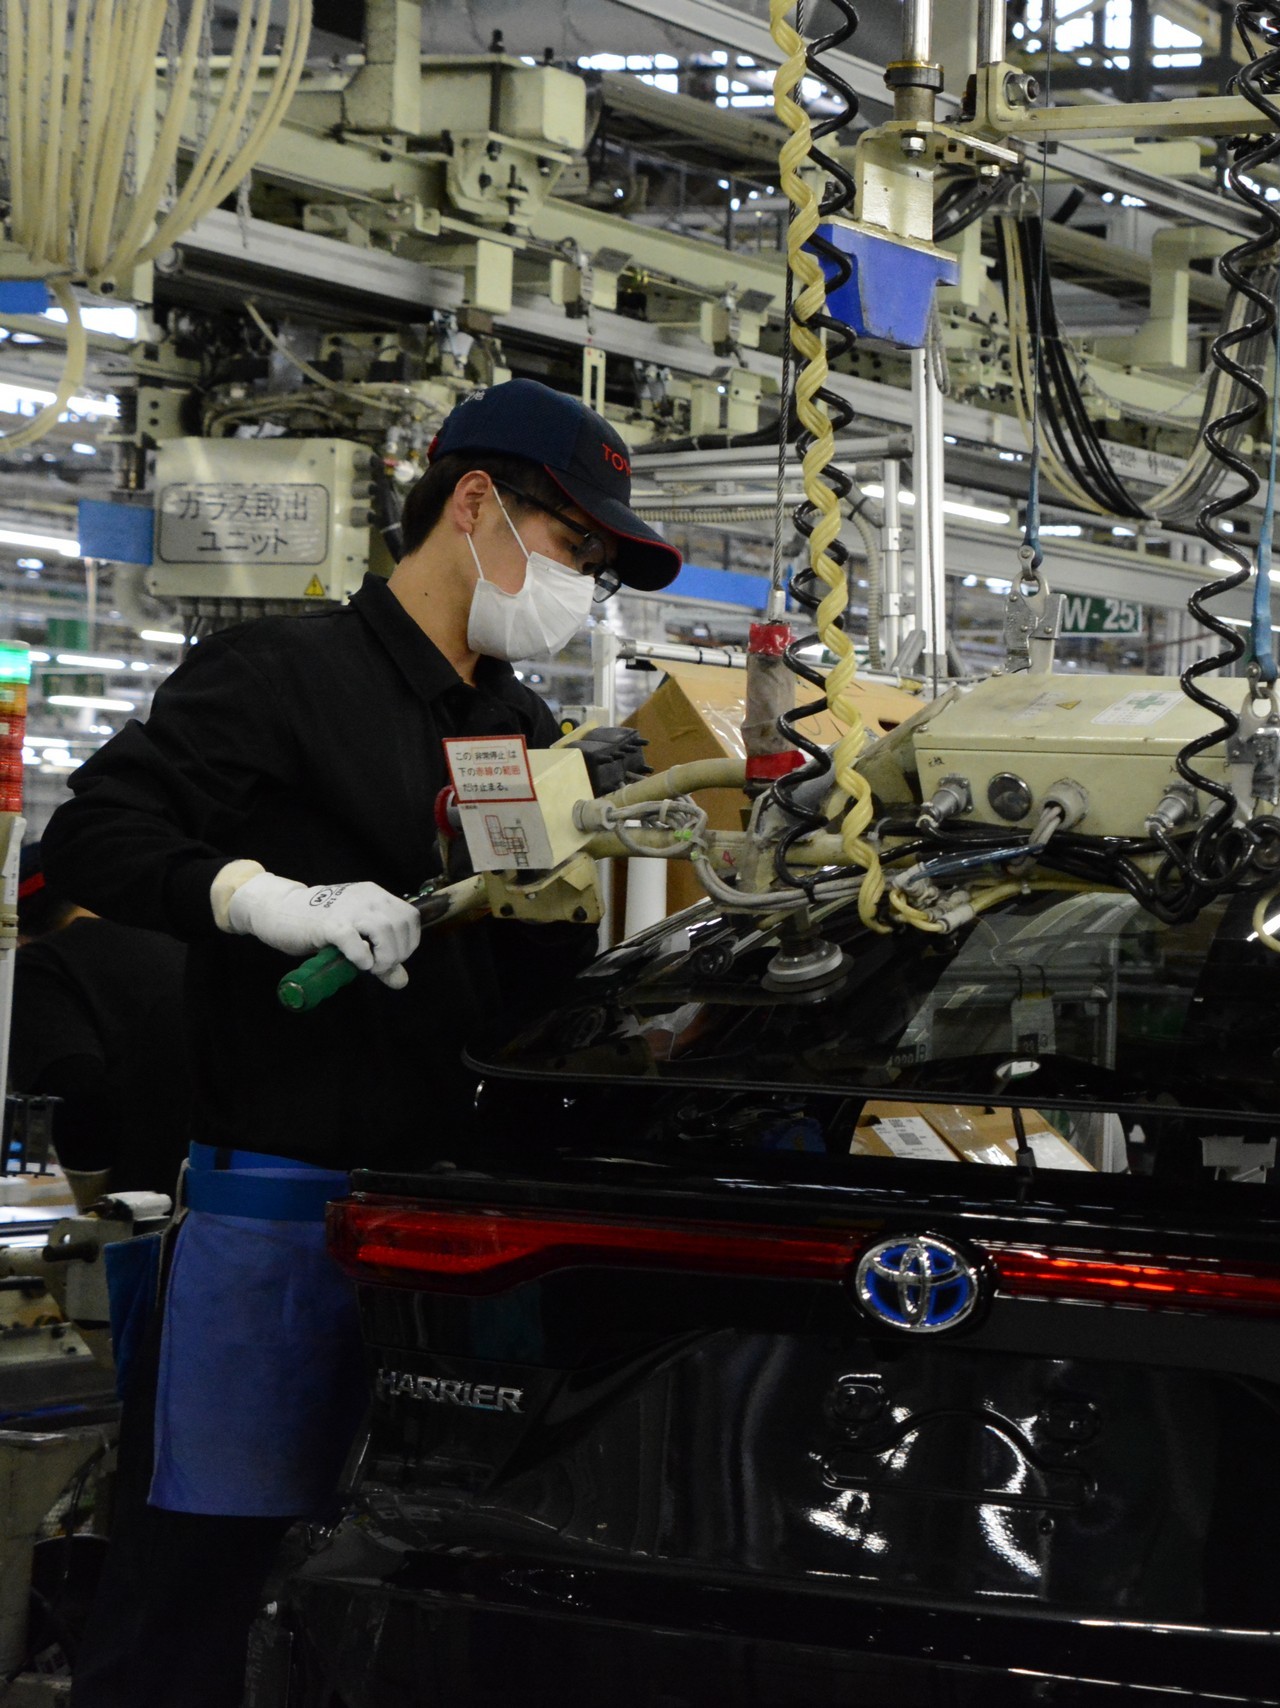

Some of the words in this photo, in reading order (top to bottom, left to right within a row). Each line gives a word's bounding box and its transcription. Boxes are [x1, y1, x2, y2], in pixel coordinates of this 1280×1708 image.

[179, 490, 308, 522] ガラス取出
[196, 528, 289, 556] ユニット
[377, 1368, 526, 1414] HARRIER
